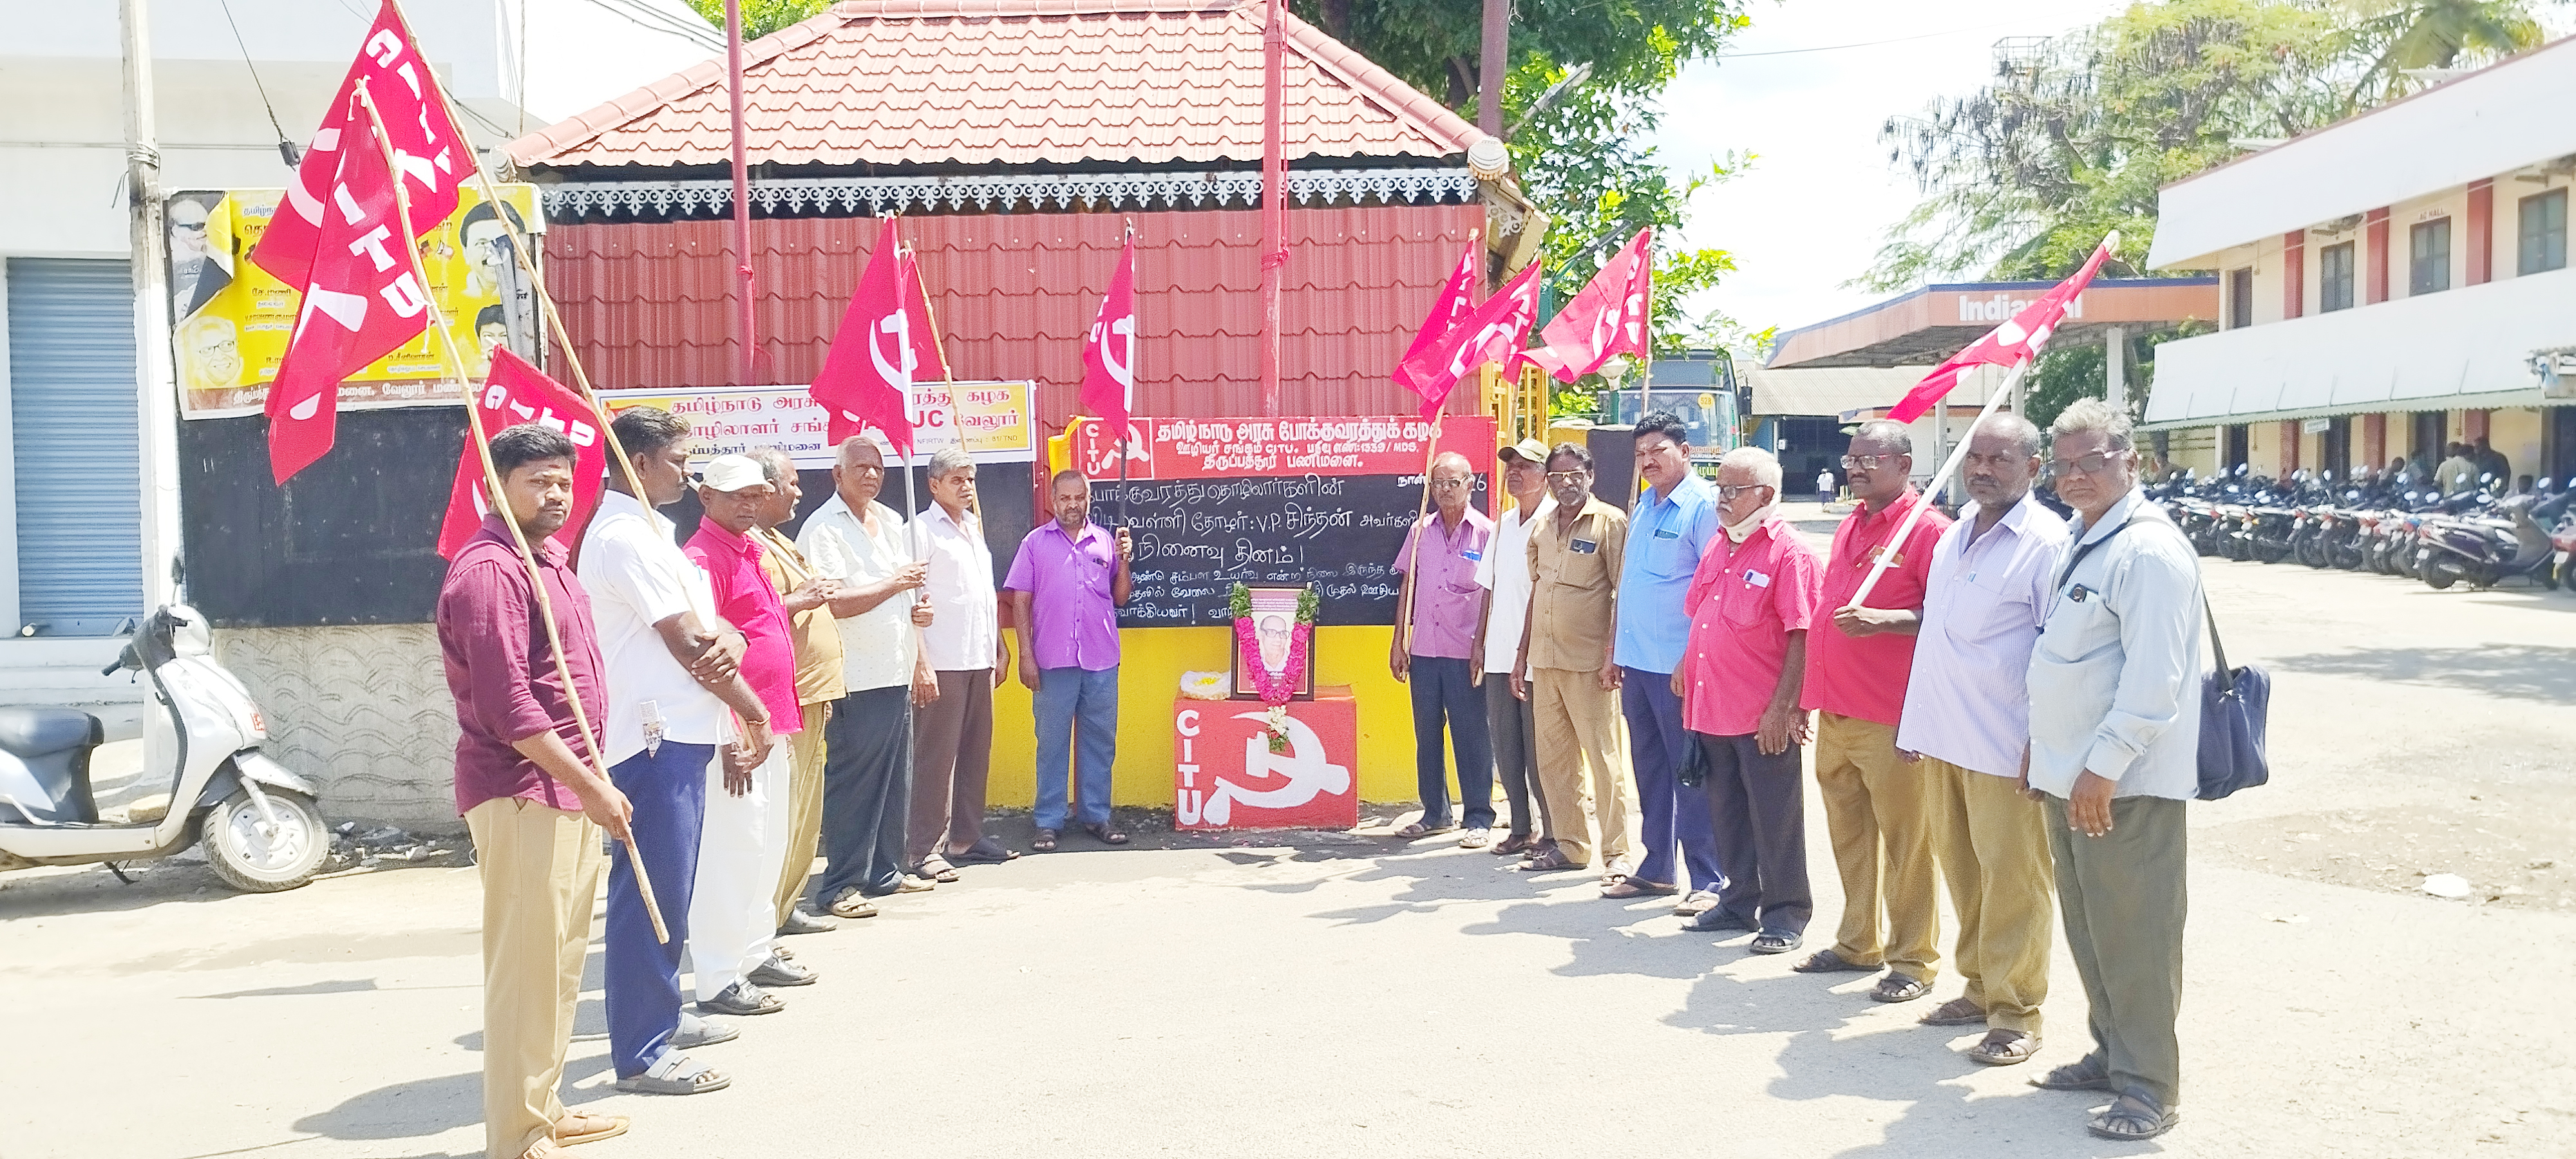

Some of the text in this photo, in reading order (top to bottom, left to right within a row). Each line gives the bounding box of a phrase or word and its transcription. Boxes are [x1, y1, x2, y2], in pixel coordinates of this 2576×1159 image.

[1959, 294, 2082, 321] Indiail
[672, 396, 762, 415] தமிழ்நாடு
[967, 390, 1010, 405] கழக
[1155, 419, 1233, 443] தமிழ்நாடு
[1236, 421, 1274, 442] அரசு
[1278, 417, 1401, 444] போக்குவரத்துக்
[1085, 423, 1101, 475] CITU
[1175, 440, 1220, 457] ஊழியர்
[1224, 440, 1262, 455] சங்கம்
[1201, 453, 1277, 471] திருப்பத்தூர்
[1285, 502, 1353, 540] சிந்தன்
[1176, 710, 1202, 826] CITU
